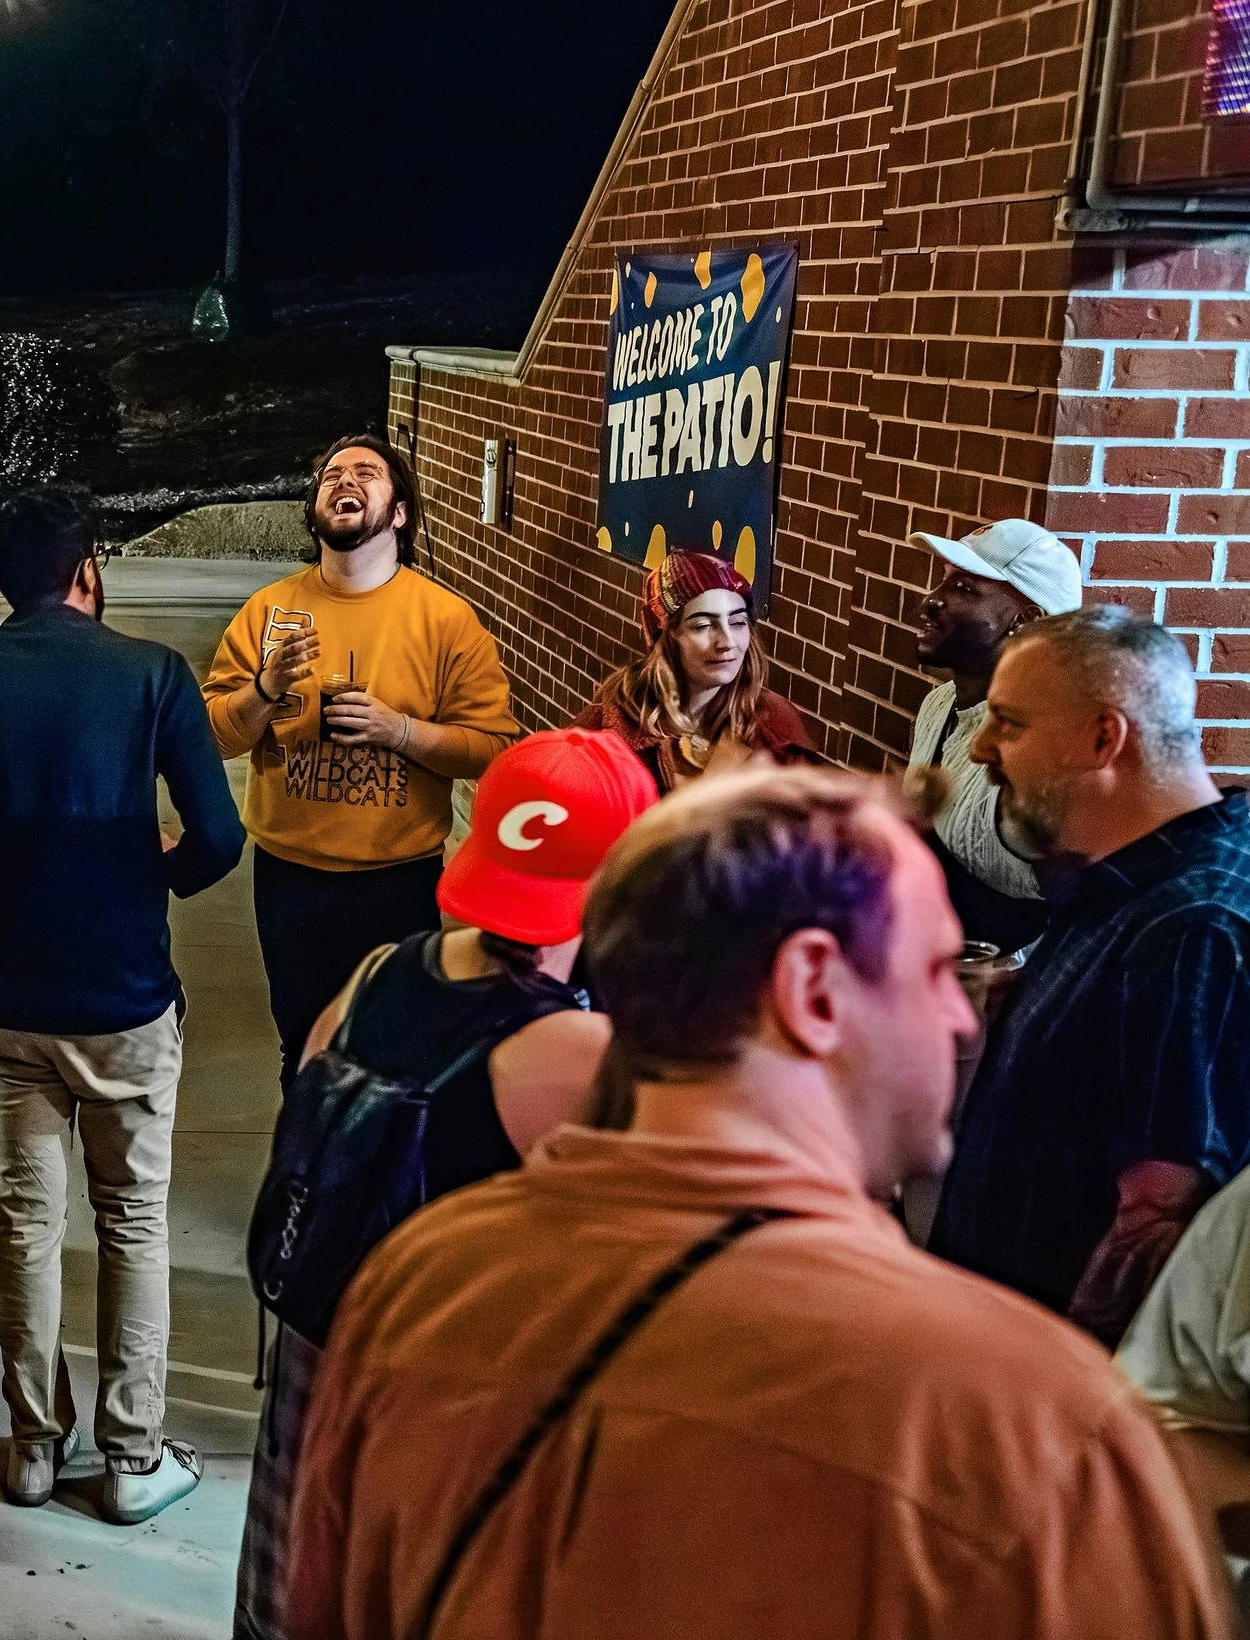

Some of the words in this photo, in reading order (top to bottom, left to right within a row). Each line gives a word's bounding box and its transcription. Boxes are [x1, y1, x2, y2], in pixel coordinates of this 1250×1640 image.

[613, 303, 705, 391] WELCOME
[706, 291, 737, 365] TO
[607, 392, 662, 484] THE
[660, 360, 781, 476] PATIO!
[285, 777, 408, 808] WILDCATS
[287, 758, 408, 788] WILDCATS
[497, 800, 569, 851] C
